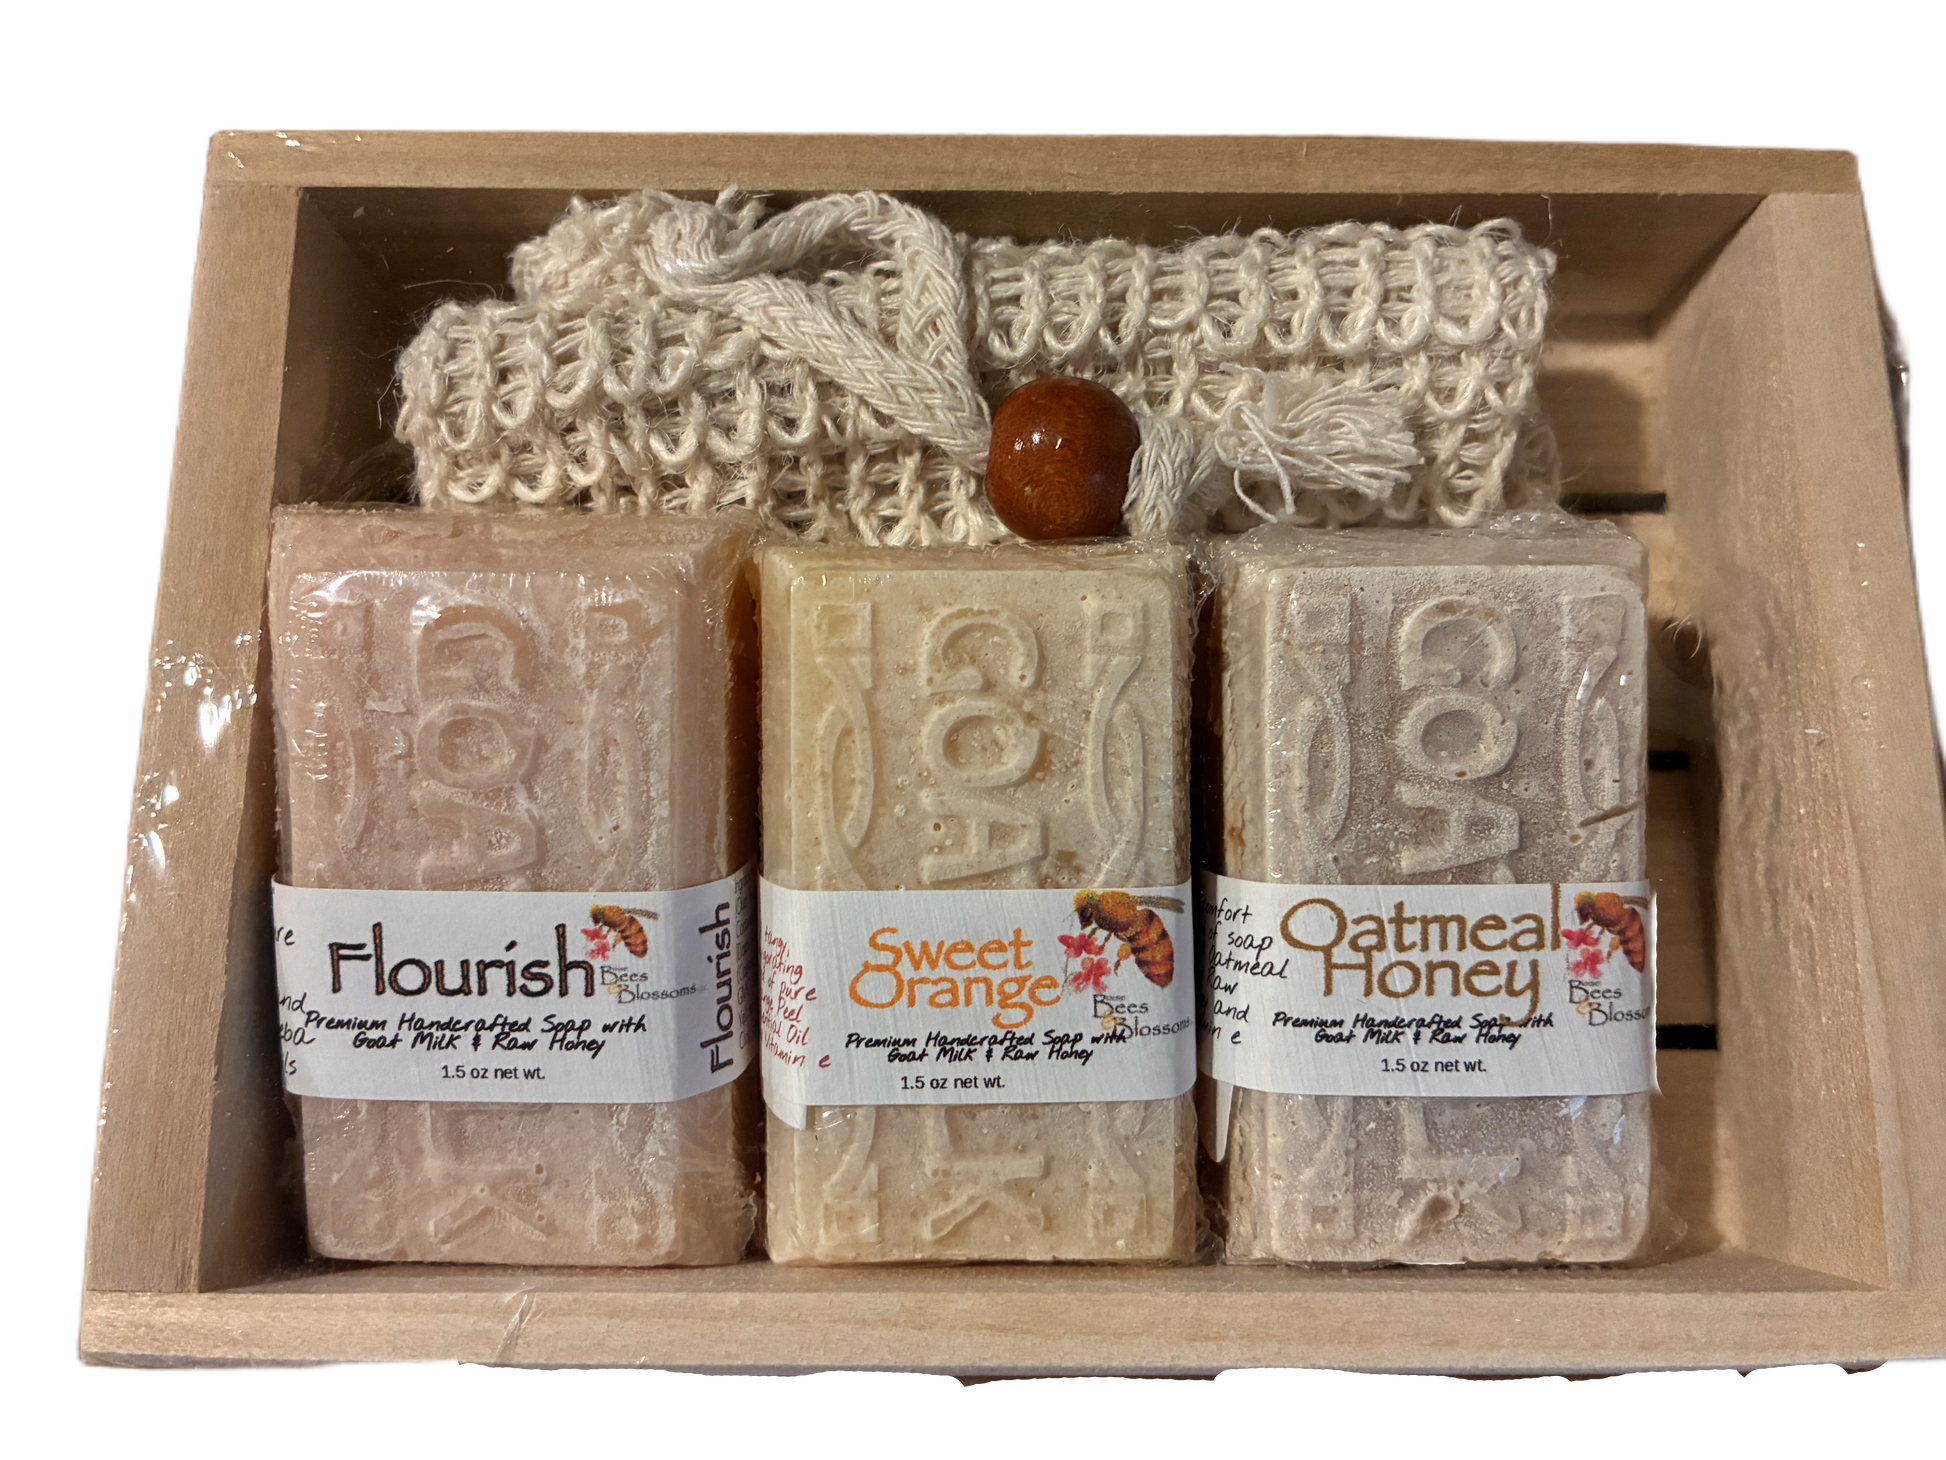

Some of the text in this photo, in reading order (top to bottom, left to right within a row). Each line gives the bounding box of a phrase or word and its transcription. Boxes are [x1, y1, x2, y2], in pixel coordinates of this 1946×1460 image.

[417, 600, 545, 890] GOA
[923, 605, 1051, 888] GOA
[1400, 595, 1522, 884] GOA
[1280, 884, 1561, 952] Oatmeal
[863, 927, 1033, 972] Sweet
[1228, 931, 1273, 961] soap
[329, 922, 595, 998] Flourish
[1208, 944, 1290, 979] Oatmeal
[600, 964, 649, 985] Bees
[618, 983, 697, 1004] Blossoms
[699, 900, 735, 1074] Flourish
[779, 979, 817, 1001] pure
[849, 963, 1062, 1029] Orange
[1322, 948, 1540, 1027] Honey
[1568, 980, 1622, 1003] Bees
[1093, 994, 1149, 1017] Bees
[1213, 999, 1250, 1023] and
[304, 1009, 647, 1035] Premium Handcrafted Soap with
[1272, 1012, 1344, 1028] Premium
[1352, 1013, 1464, 1028] Handcrafted
[352, 1031, 402, 1049] Goat
[412, 1031, 459, 1051] Milk
[492, 1034, 537, 1051] Raw
[550, 1033, 606, 1059] Honey
[787, 1023, 810, 1046] Oil
[845, 1029, 1127, 1049] Premium Handcrafted Soap with
[1230, 1030, 1241, 1044] e
[1314, 1029, 1356, 1044] Goat
[1363, 1029, 1404, 1044] Milk
[1429, 1030, 1466, 1043] Raw
[1475, 1029, 1522, 1050] Honey
[819, 1054, 832, 1068] e
[887, 1047, 929, 1063] Goat
[936, 1046, 977, 1062] Milk
[1001, 1046, 1038, 1061] Raw
[1047, 1046, 1094, 1065] Honey
[1380, 1058, 1487, 1072] 1.5 oz net wt.
[441, 1064, 546, 1080] 1.5 oz net wt.
[900, 1075, 1005, 1089] 1.5 oz net wt.
